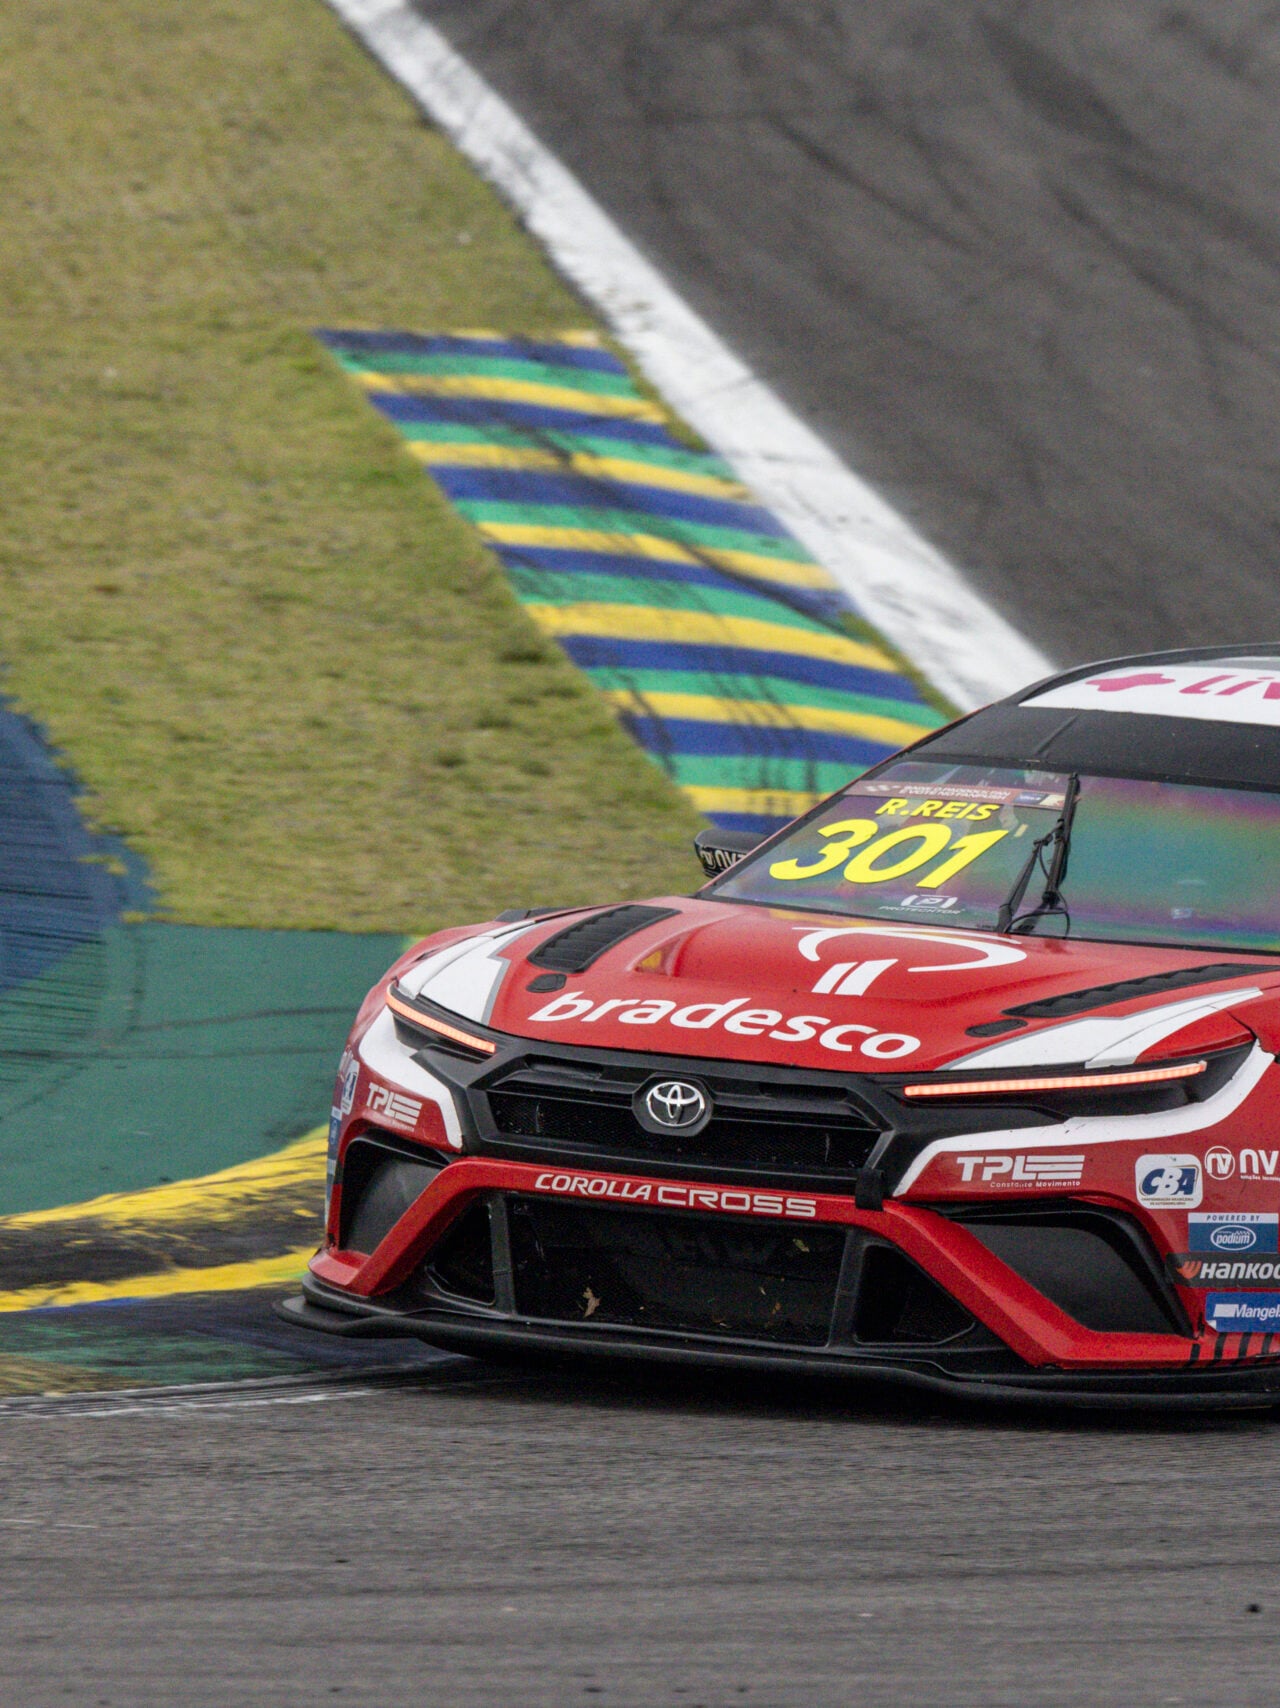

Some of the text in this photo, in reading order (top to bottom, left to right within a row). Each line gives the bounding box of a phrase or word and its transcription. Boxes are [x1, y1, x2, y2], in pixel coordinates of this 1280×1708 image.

[875, 798, 1000, 821] R.REIS
[769, 818, 1009, 889] 301
[527, 991, 922, 1060] bradesco
[534, 1172, 818, 1218] COROLLA CROSS
[1141, 1168, 1197, 1196] CBA
